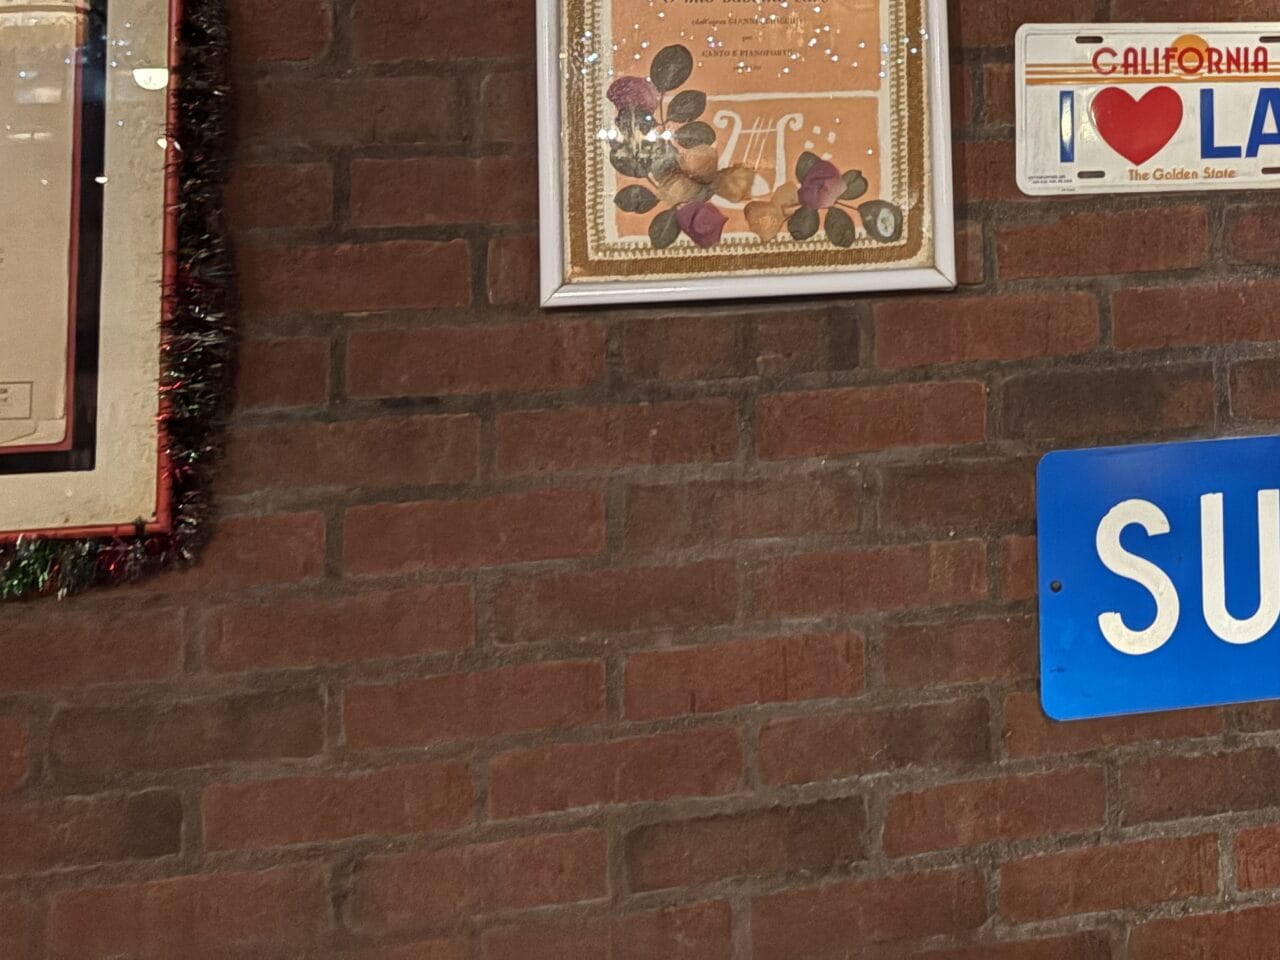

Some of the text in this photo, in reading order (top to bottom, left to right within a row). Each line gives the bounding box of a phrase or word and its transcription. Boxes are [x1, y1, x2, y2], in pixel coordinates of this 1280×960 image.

[1092, 46, 1268, 75] CALIFORNIA
[1060, 90, 1075, 163] I
[1128, 166, 1237, 181] The Golden State
